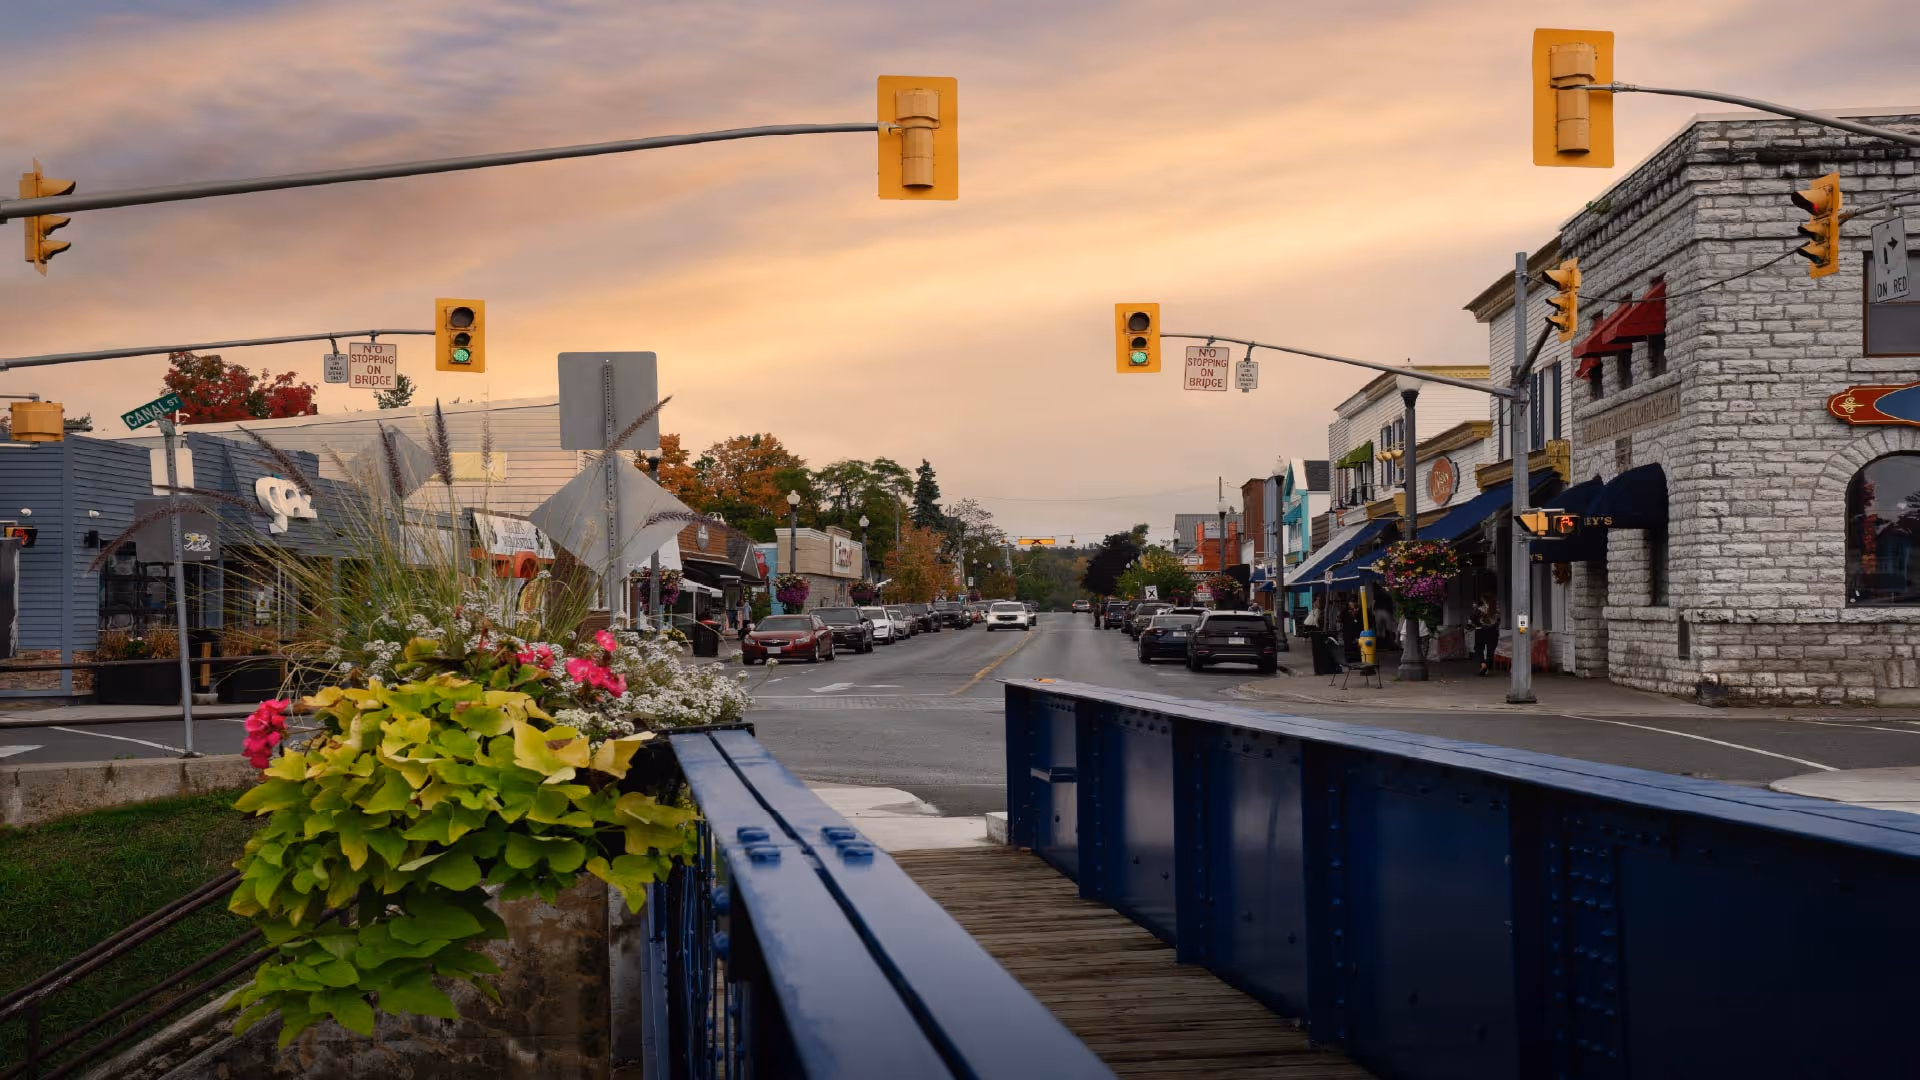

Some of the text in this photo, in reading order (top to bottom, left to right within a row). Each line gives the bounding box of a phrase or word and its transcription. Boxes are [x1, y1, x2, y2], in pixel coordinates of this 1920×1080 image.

[1877, 276, 1907, 298] ON RED
[363, 345, 383, 354] NO
[1198, 348, 1217, 358] NO
[351, 354, 394, 365] STOPPING
[1187, 357, 1227, 368] STOPPING
[367, 364, 381, 375] ON
[1200, 367, 1214, 377] ON
[354, 375, 392, 386] BRIDGE
[1189, 377, 1224, 388] BRIDGE
[125, 397, 179, 427] CANAL ST
